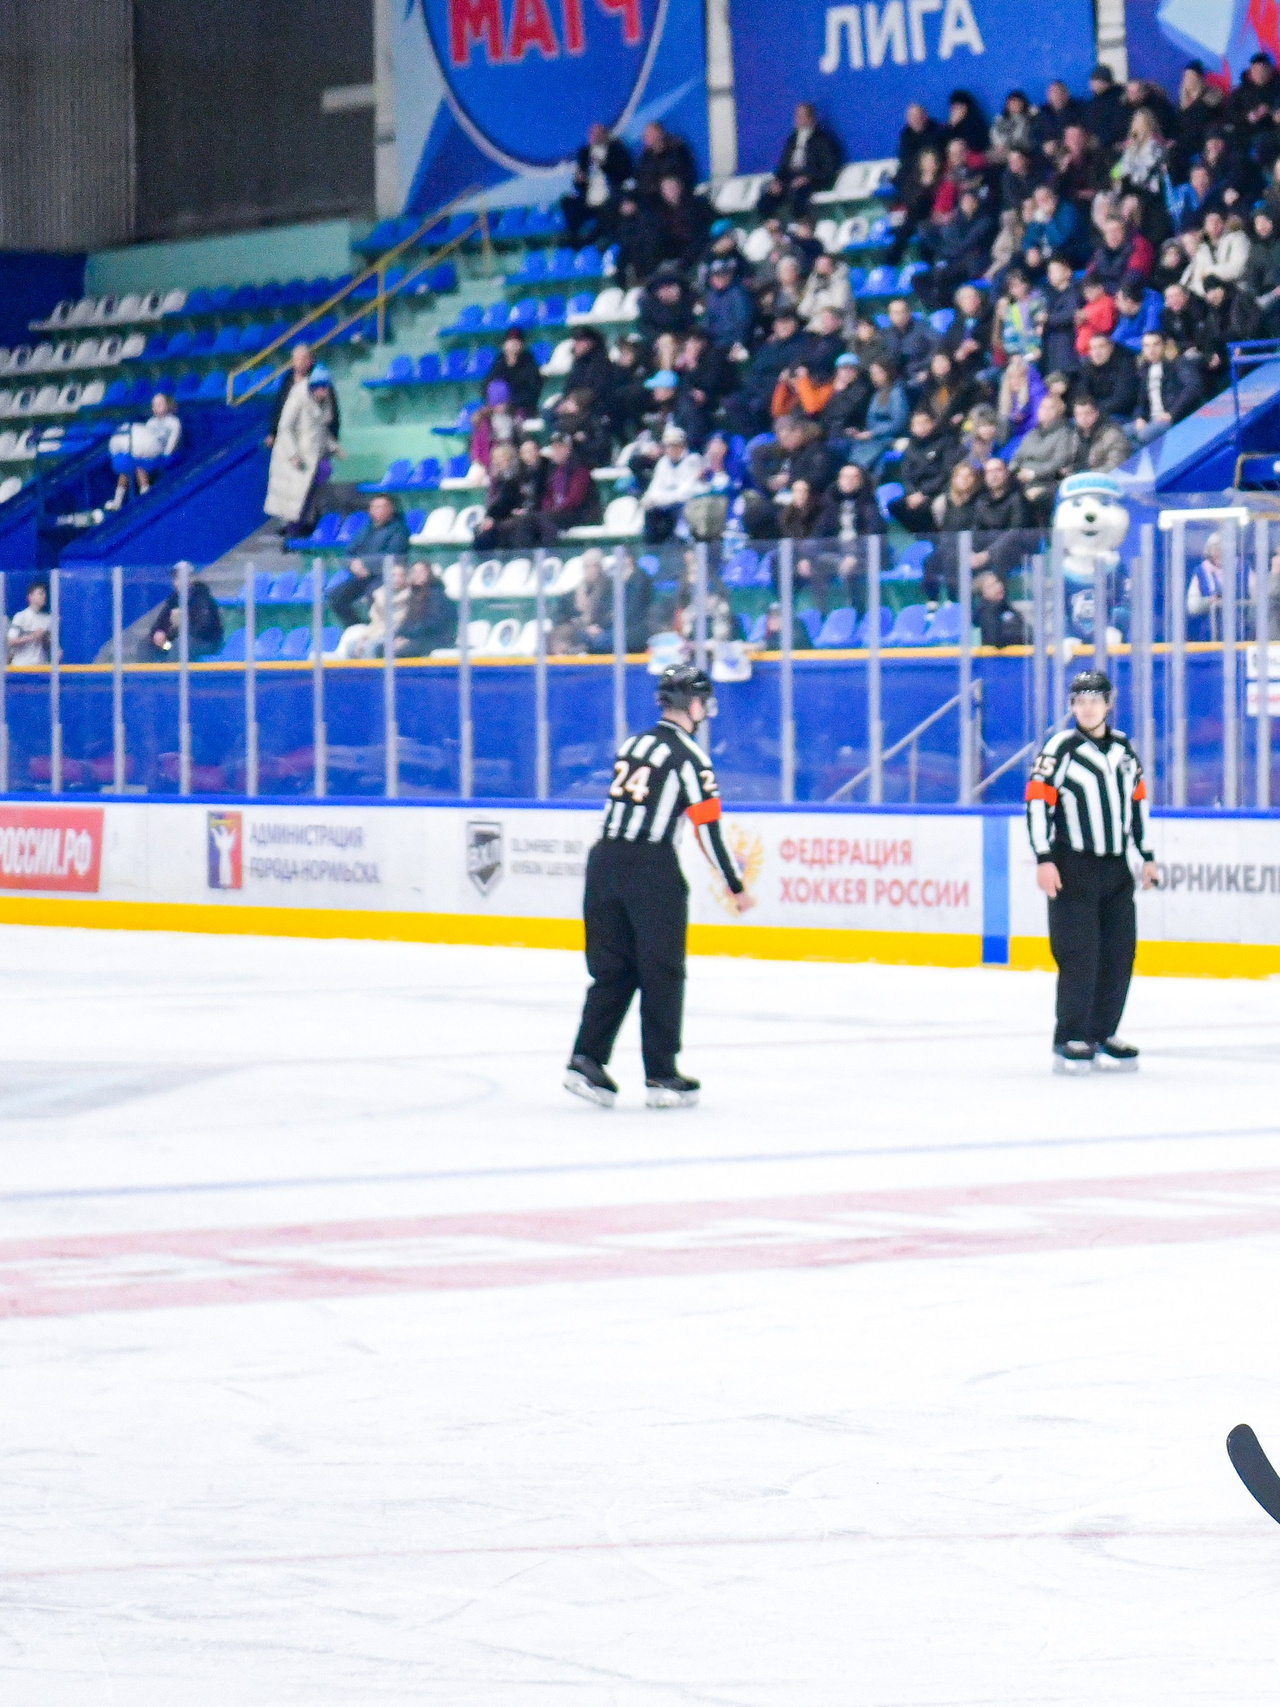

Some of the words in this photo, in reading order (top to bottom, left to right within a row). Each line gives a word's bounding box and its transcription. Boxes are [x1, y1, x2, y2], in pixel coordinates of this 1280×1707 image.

[820, 0, 985, 72] ЛИГА
[609, 760, 651, 803] 24
[779, 837, 912, 869] ФЕДЕРАЦИЯ
[779, 875, 867, 905] ХОККЕЯ
[874, 877, 970, 907] РОССИИ
